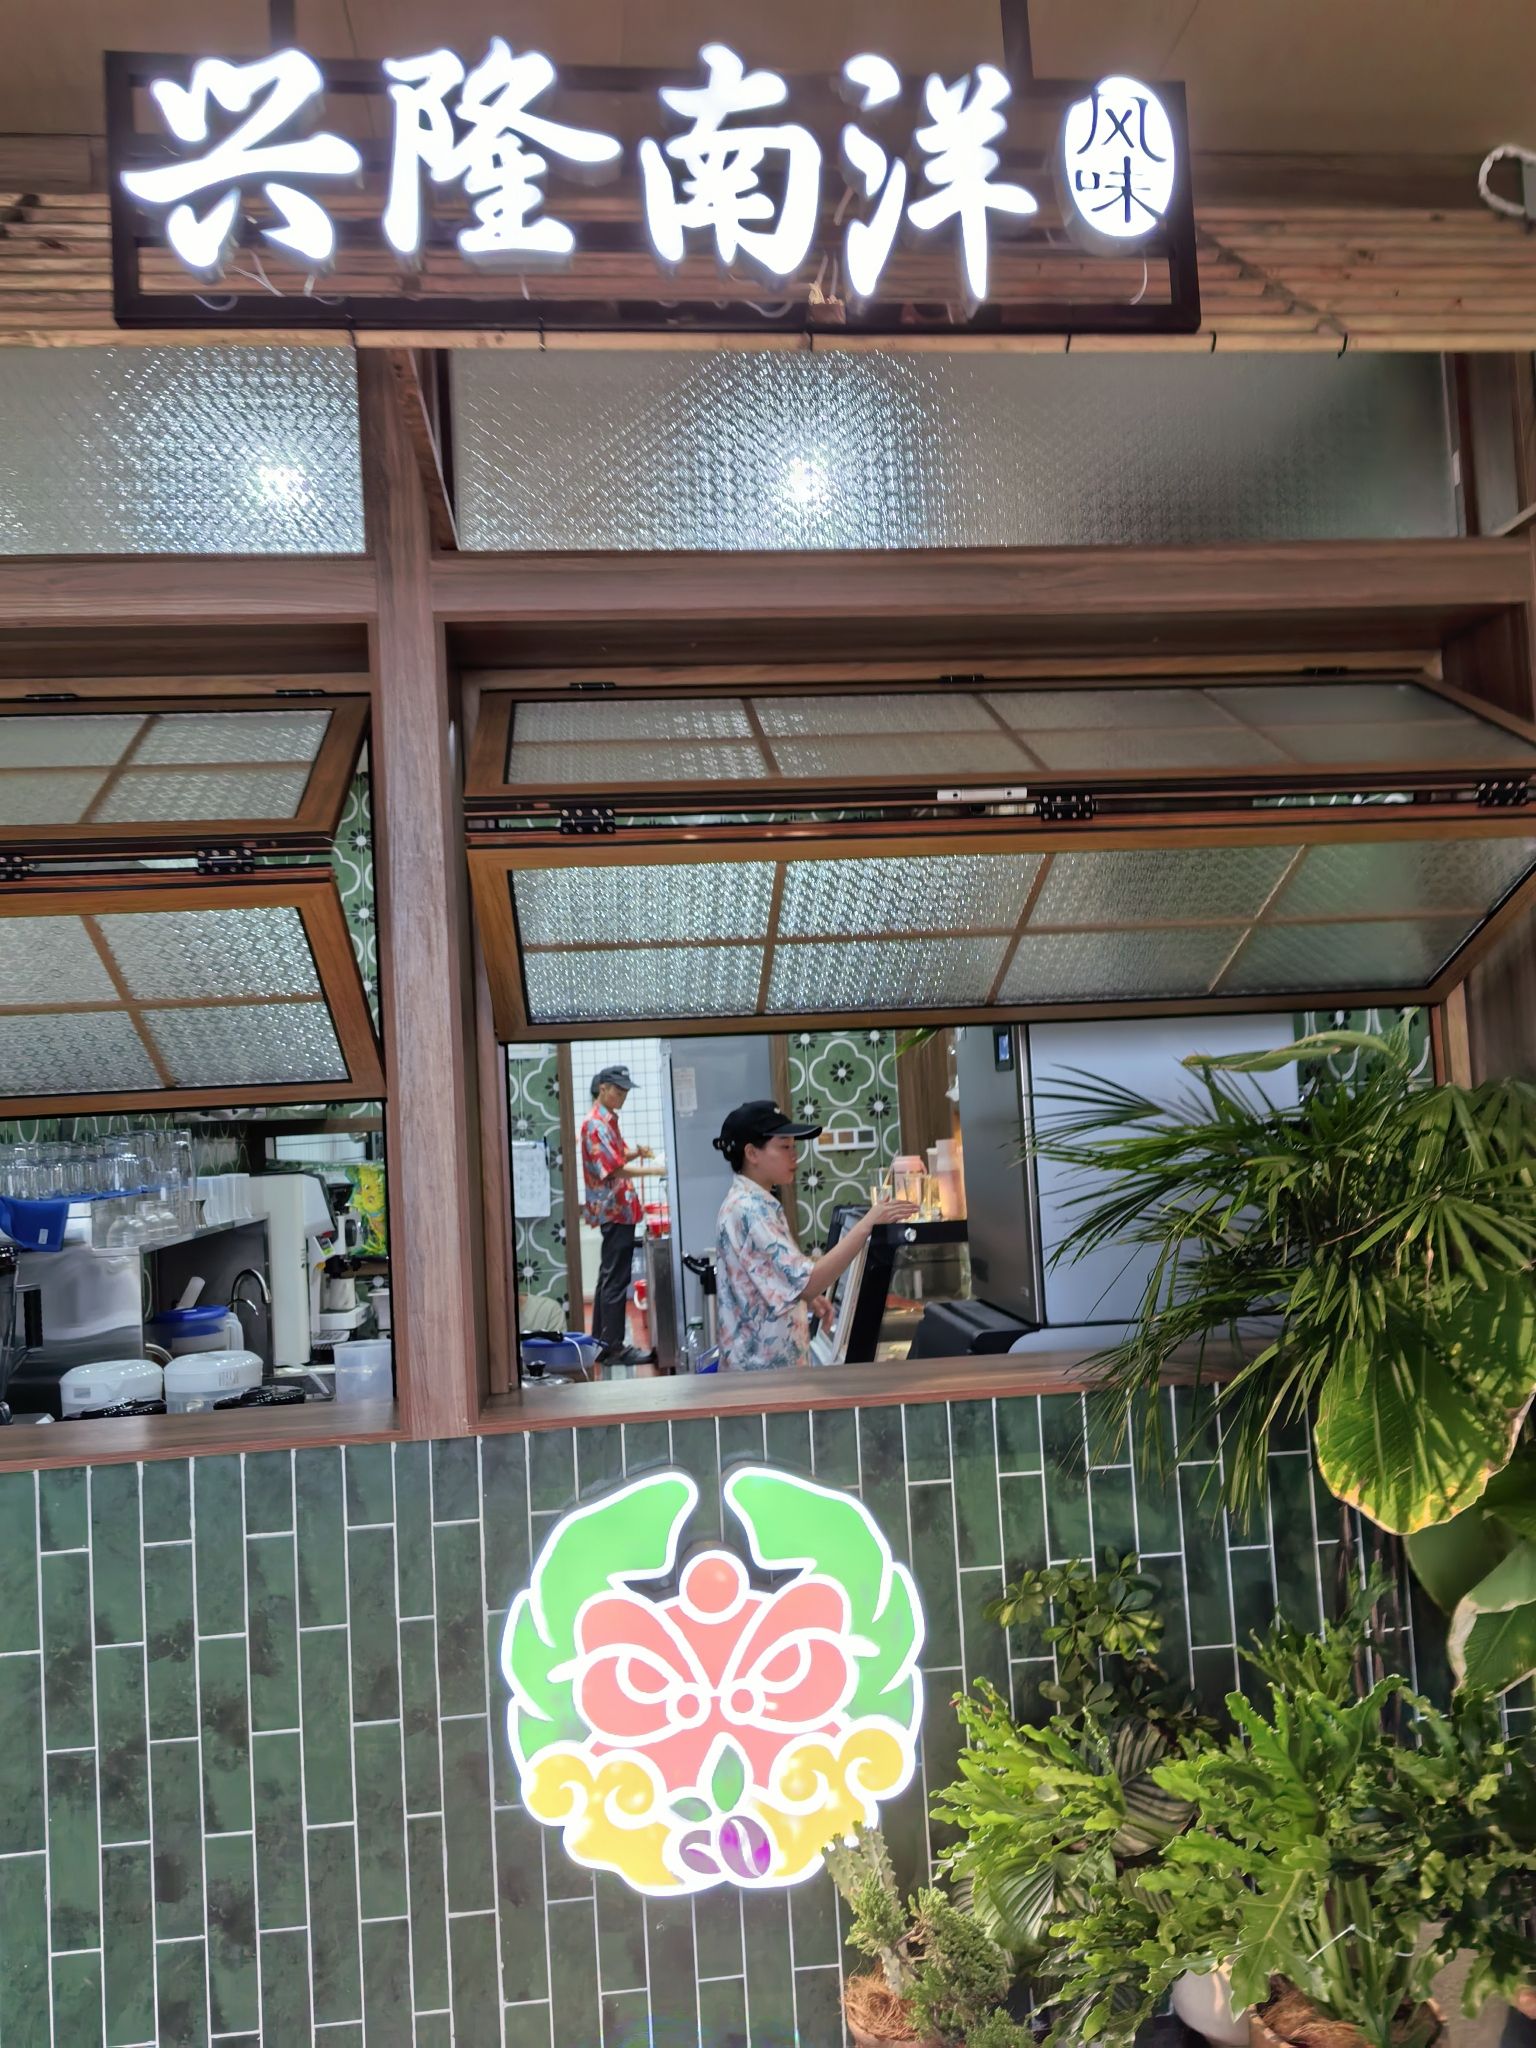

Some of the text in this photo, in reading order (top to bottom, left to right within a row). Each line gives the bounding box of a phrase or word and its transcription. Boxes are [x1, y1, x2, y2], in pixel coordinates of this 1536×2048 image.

[120, 38, 1038, 300] 兴隆南洋
[1074, 76, 1168, 224] 风味
